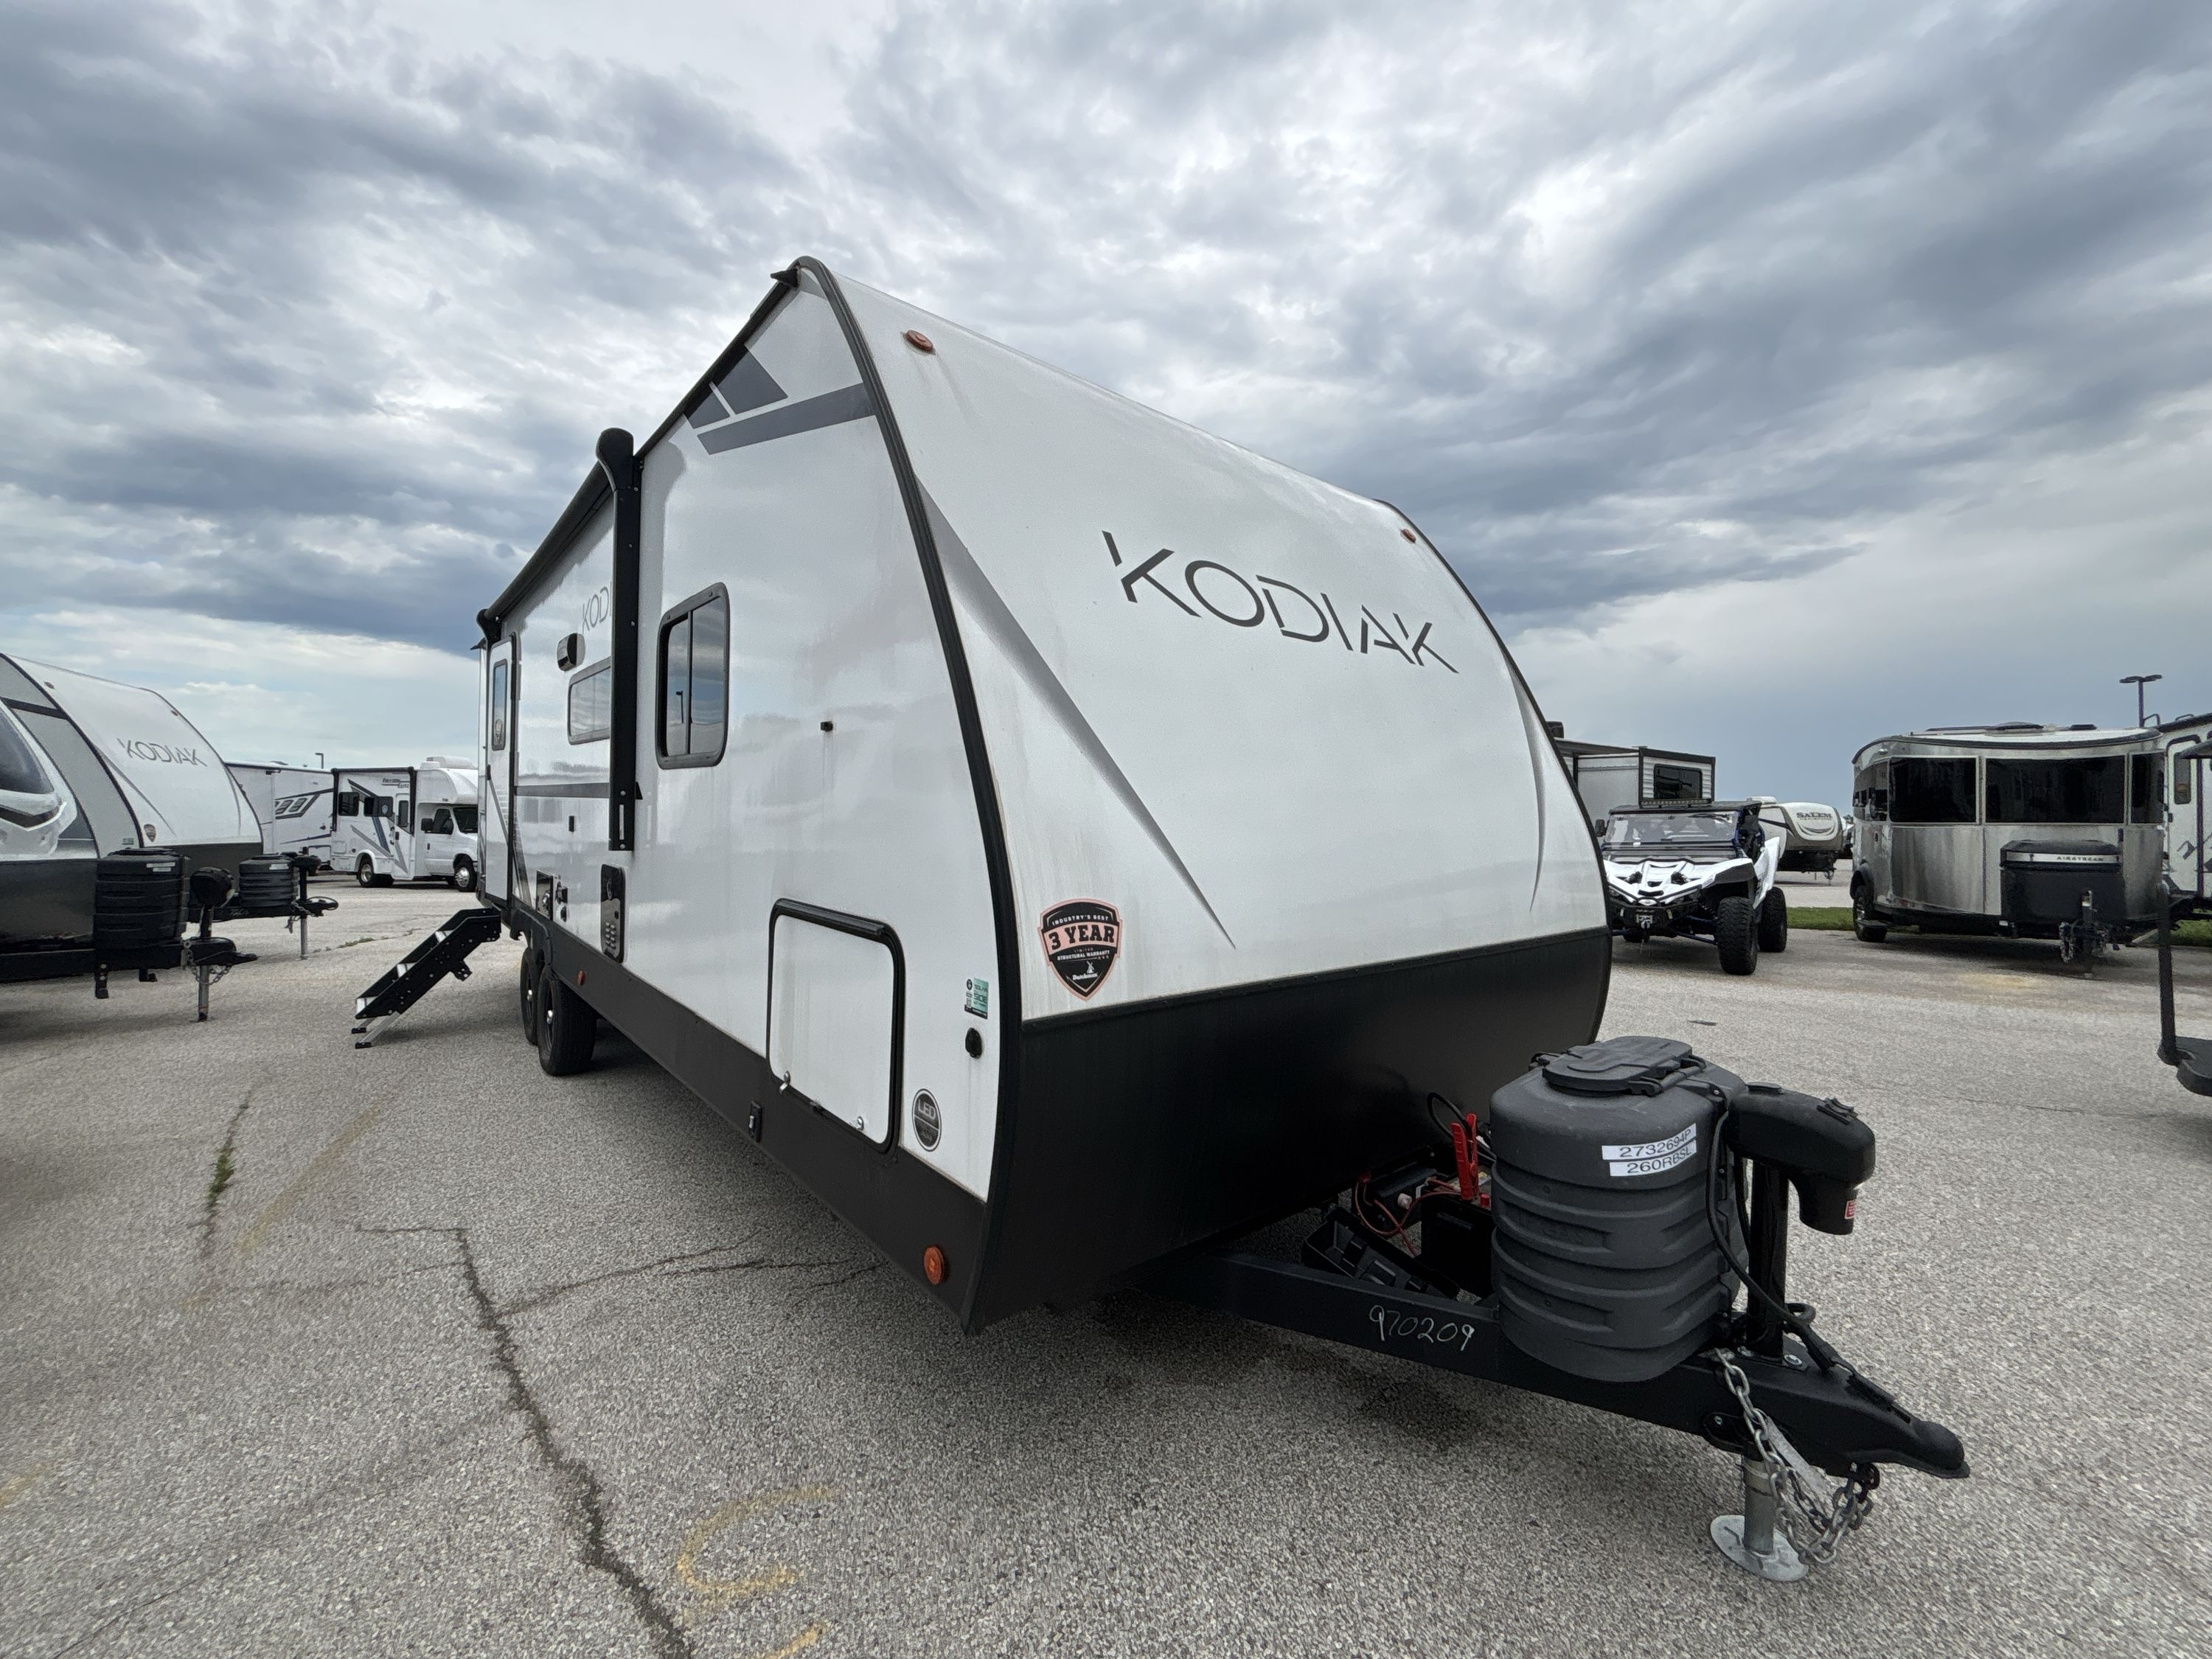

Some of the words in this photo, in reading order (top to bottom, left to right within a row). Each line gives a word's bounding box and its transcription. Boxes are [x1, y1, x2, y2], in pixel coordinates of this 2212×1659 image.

[581, 581, 612, 635] KODI
[1102, 529, 1460, 674] KODIAK
[116, 737, 208, 767] KODIAK
[1051, 914, 1091, 926] INDUSTRY'S
[1048, 931, 1062, 950] 3
[1064, 924, 1115, 944] YEAR
[918, 1098, 936, 1120] LED
[1619, 1128, 1692, 1158] 2732694P
[1627, 1146, 1692, 1175] 260RBSL
[1368, 1304, 1475, 1352] 970209
